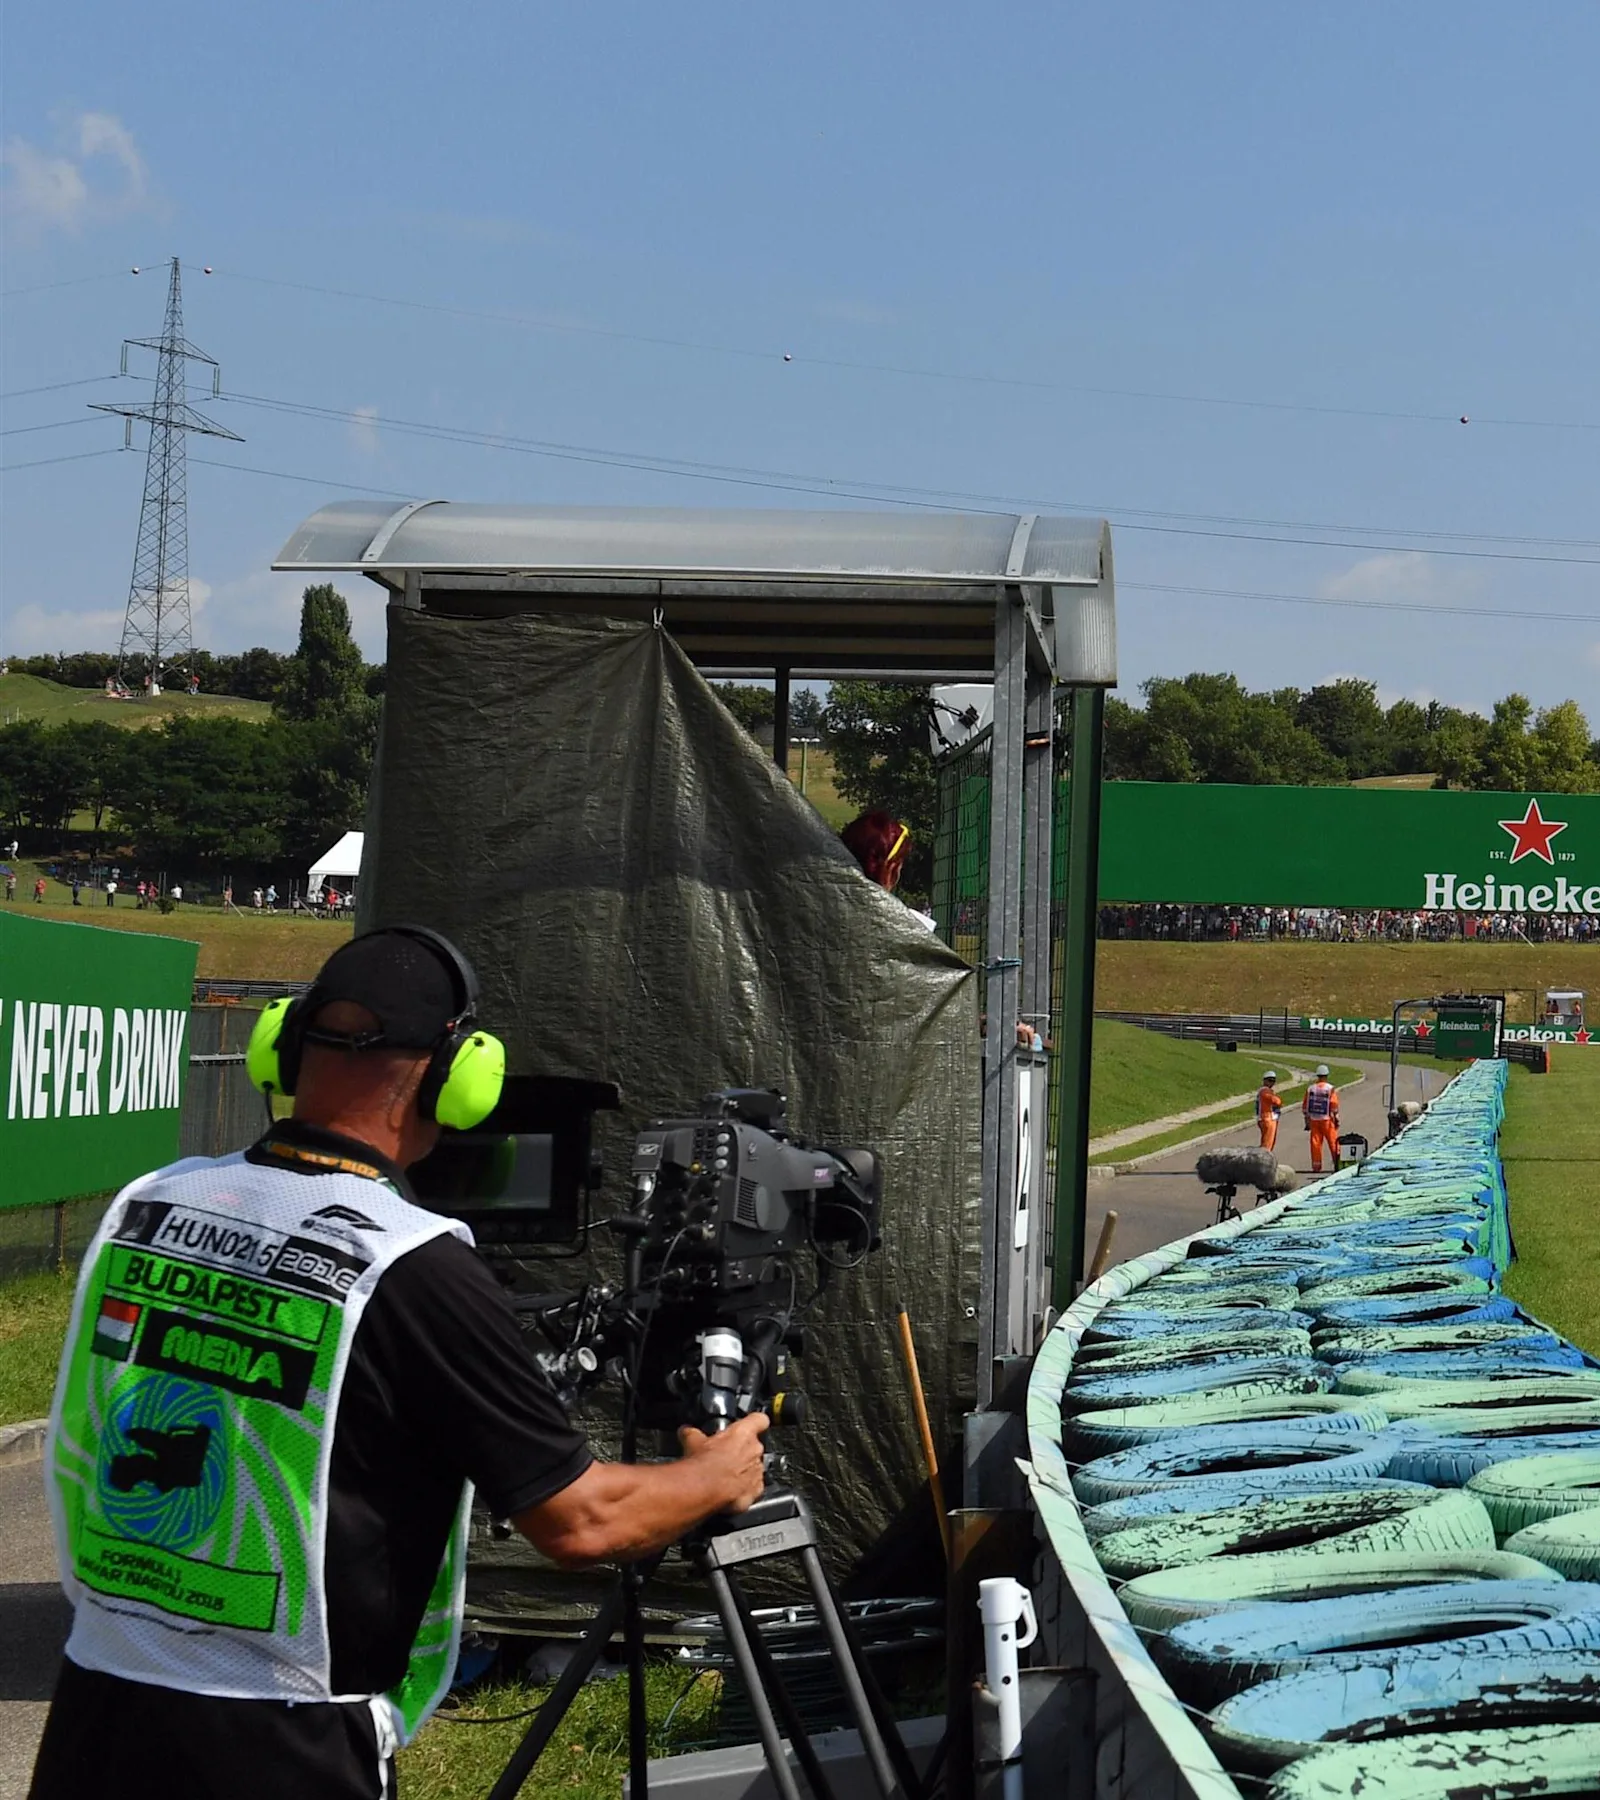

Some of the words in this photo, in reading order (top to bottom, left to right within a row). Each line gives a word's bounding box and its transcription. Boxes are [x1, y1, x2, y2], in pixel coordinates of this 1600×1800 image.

[1490, 851, 1507, 860] EST.
[1558, 853, 1576, 861] 1873
[1440, 1021, 1480, 1031] Heineken
[8, 1000, 104, 1119] NEVER
[109, 1008, 187, 1114] DRINK
[160, 1215, 281, 1268] HUN0215
[124, 1256, 292, 1323] BUDAPEST
[160, 1326, 283, 1388] MEDIA
[185, 1589, 225, 1611] 2018
